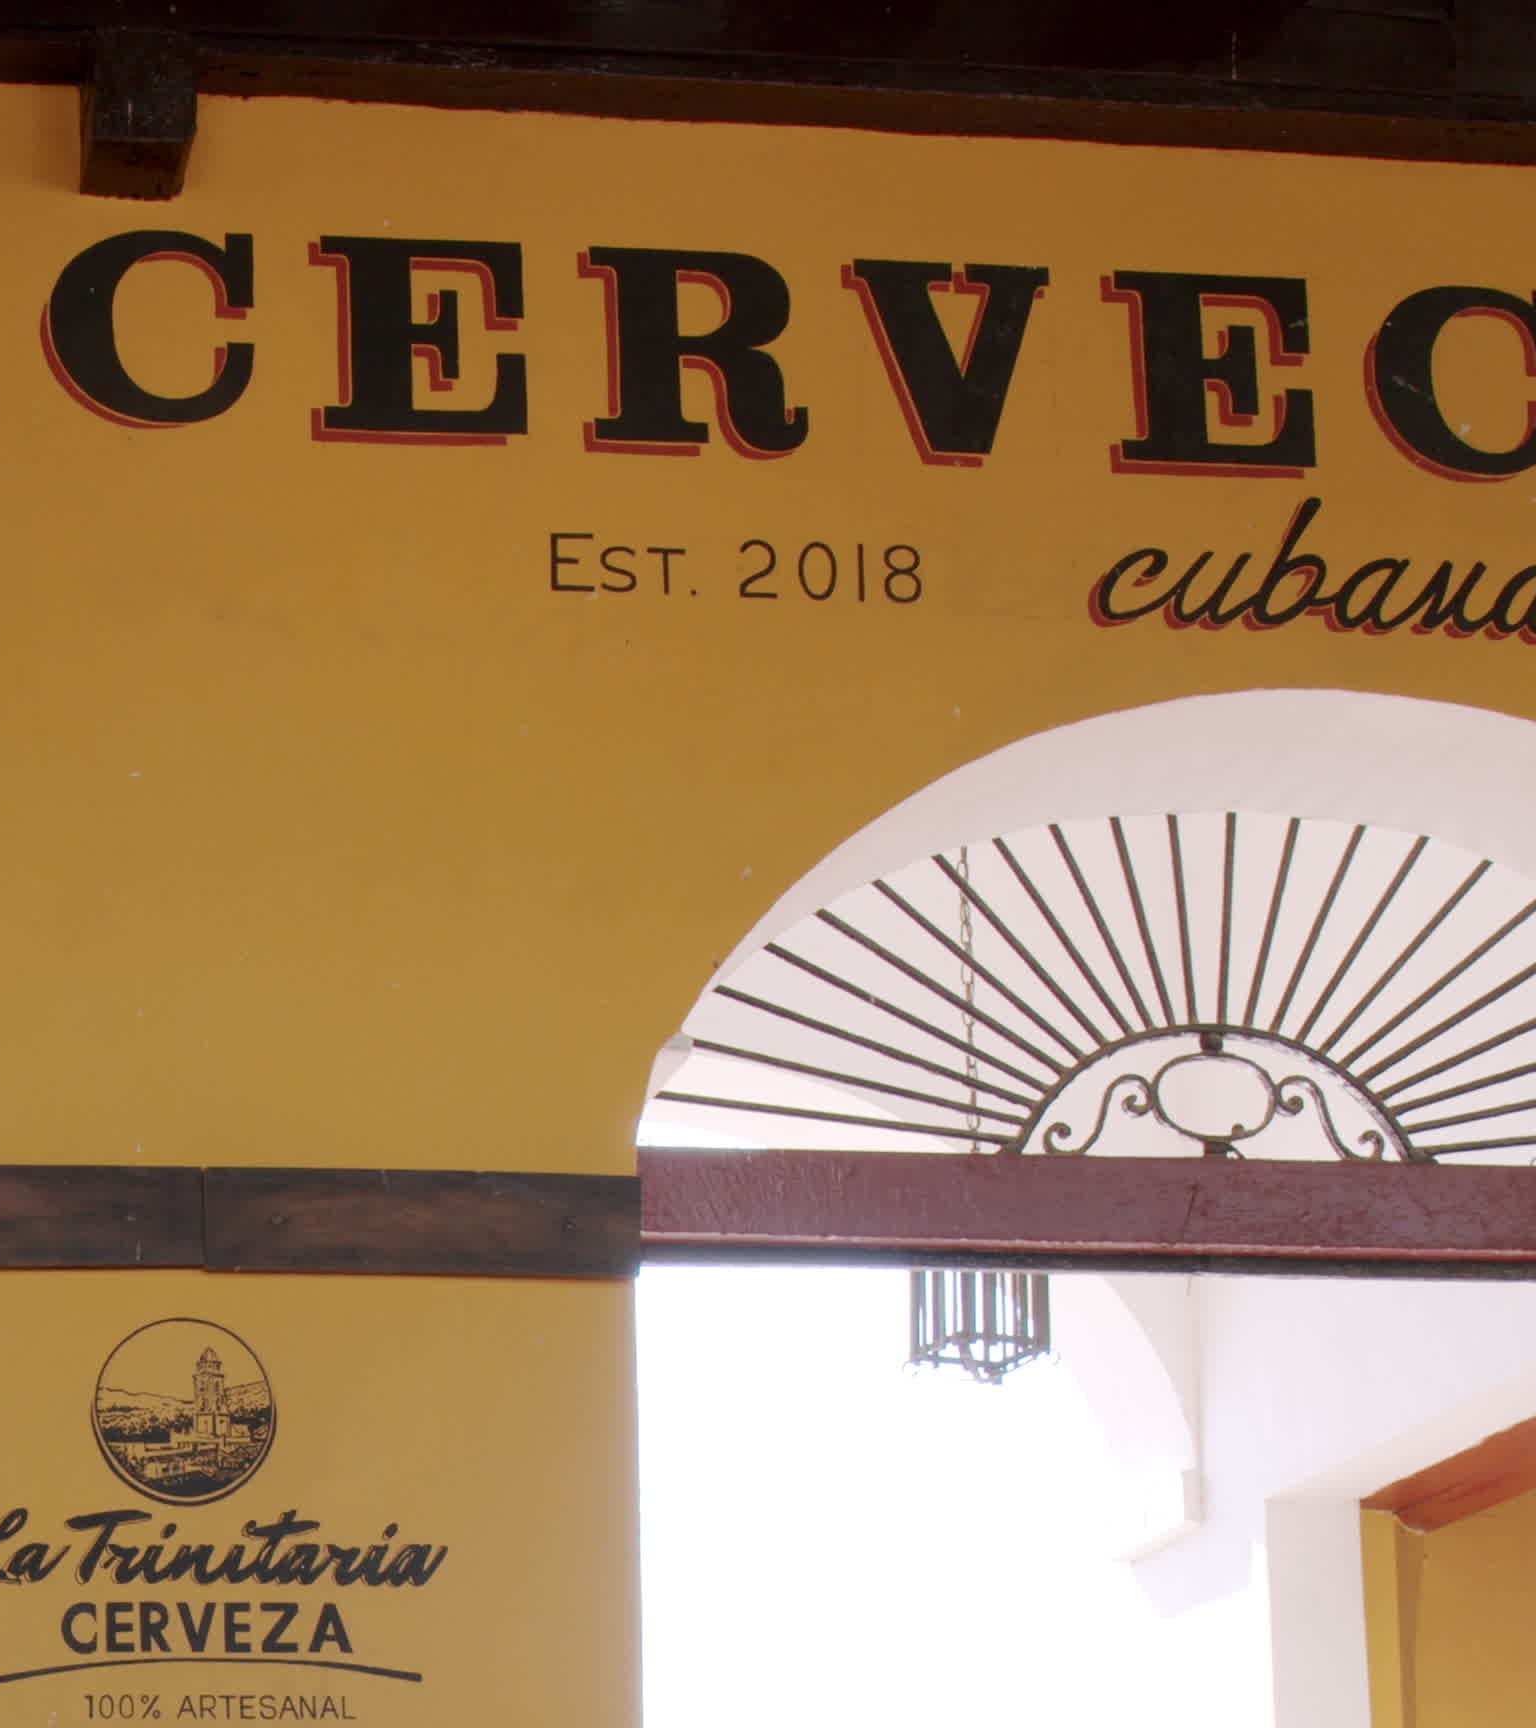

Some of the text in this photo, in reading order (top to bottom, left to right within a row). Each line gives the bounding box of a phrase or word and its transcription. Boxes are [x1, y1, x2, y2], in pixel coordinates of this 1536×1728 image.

[737, 540, 926, 605] 2018
[65, 1508, 449, 1589] Trinitaria
[60, 1601, 354, 1655] CERVEZA
[83, 1693, 358, 1722] 100% ARTESANAL
